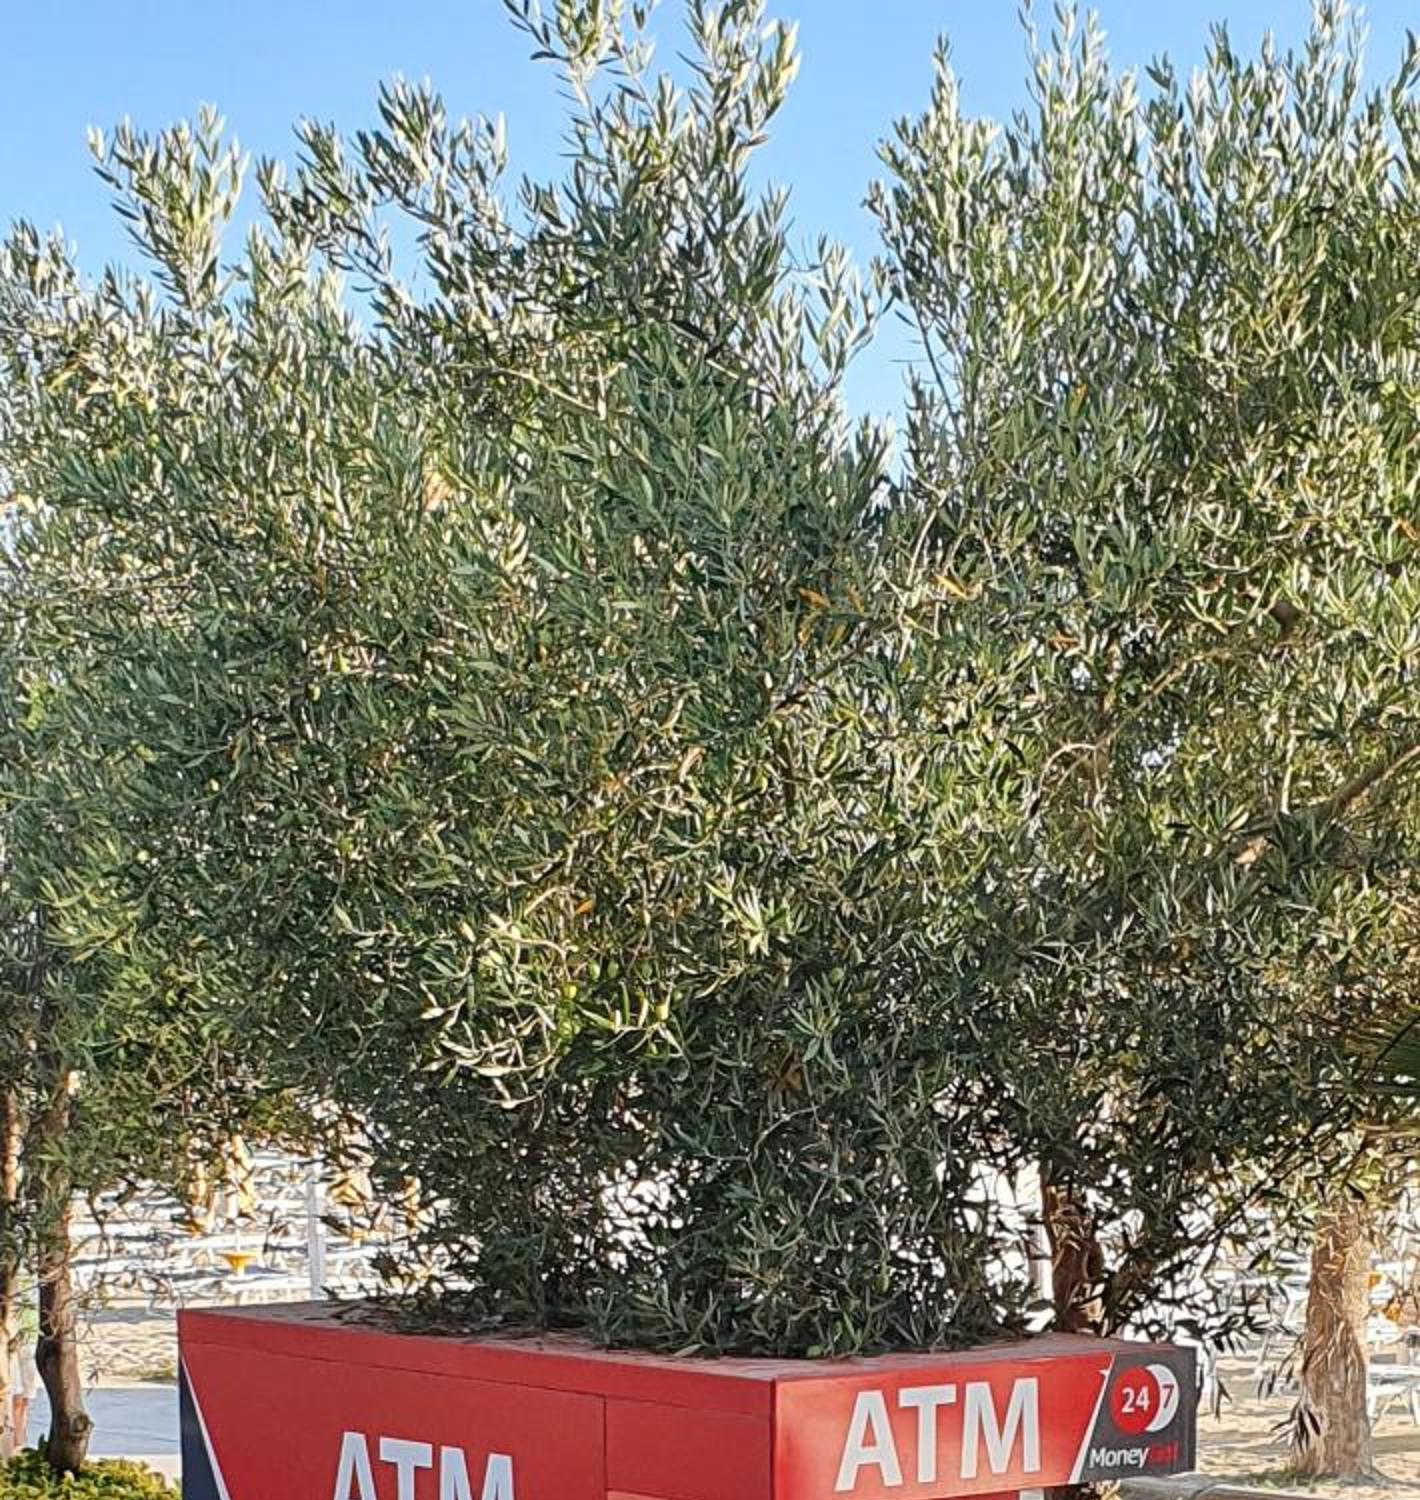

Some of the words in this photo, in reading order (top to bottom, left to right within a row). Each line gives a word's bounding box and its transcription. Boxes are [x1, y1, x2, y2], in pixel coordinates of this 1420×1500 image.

[834, 1377, 1041, 1492] ATM
[1120, 1385, 1151, 1414] 24
[1161, 1383, 1175, 1409] 7
